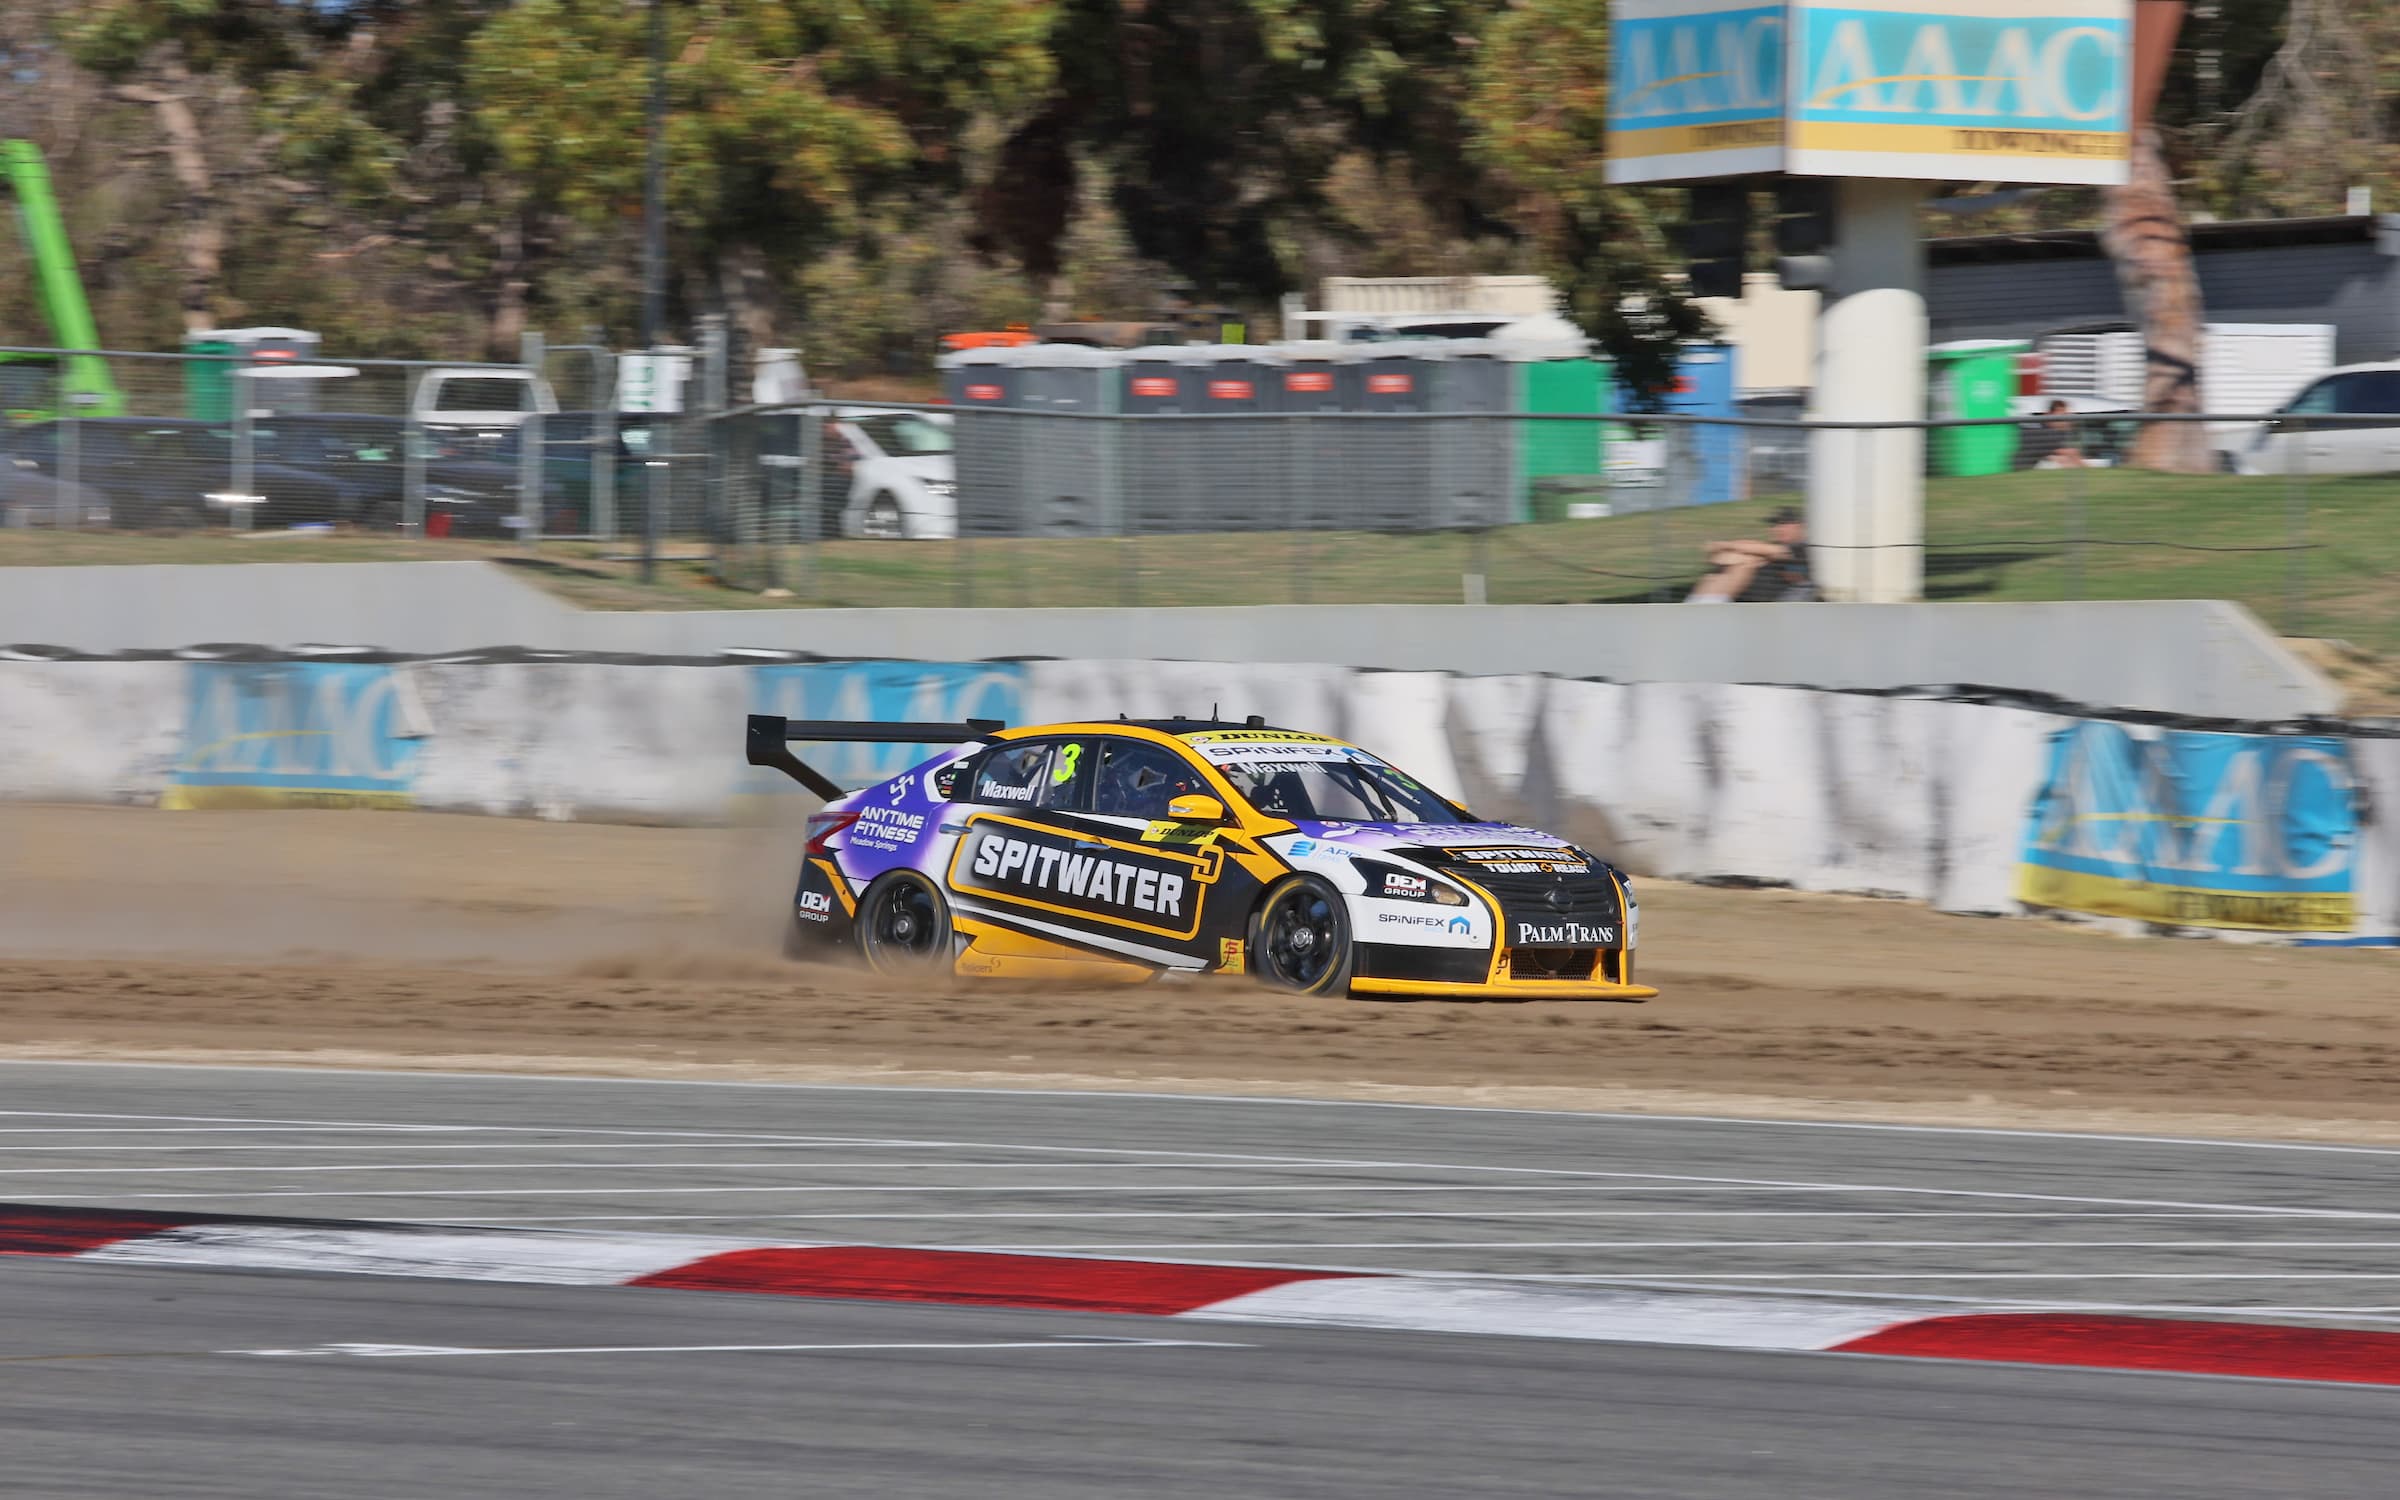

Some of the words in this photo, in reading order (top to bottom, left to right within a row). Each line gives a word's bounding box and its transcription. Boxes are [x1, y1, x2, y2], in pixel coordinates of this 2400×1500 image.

[1803, 20, 2122, 120] AAAC
[1218, 732, 1331, 742] DUNLOP
[1053, 743, 1081, 782] 3
[1238, 762, 1327, 775] Maxwell
[1383, 768, 1421, 791] 3
[981, 780, 1037, 801] Maxwell
[860, 806, 925, 829] ANYTIME
[853, 821, 919, 844] FITNESS
[1160, 828, 1215, 838] DUNLOP
[850, 836, 875, 847] Meadow
[874, 840, 898, 852] Springs
[974, 834, 1184, 917] SPITWATER
[1482, 863, 1541, 874] TOUGH
[1554, 864, 1591, 874] READY
[1385, 873, 1427, 890] OEM
[800, 891, 831, 912] OEM
[1384, 887, 1426, 898] GROUP
[799, 911, 829, 923] GROUP
[1518, 923, 1564, 944] PALM
[1565, 922, 1614, 944] TRANS
